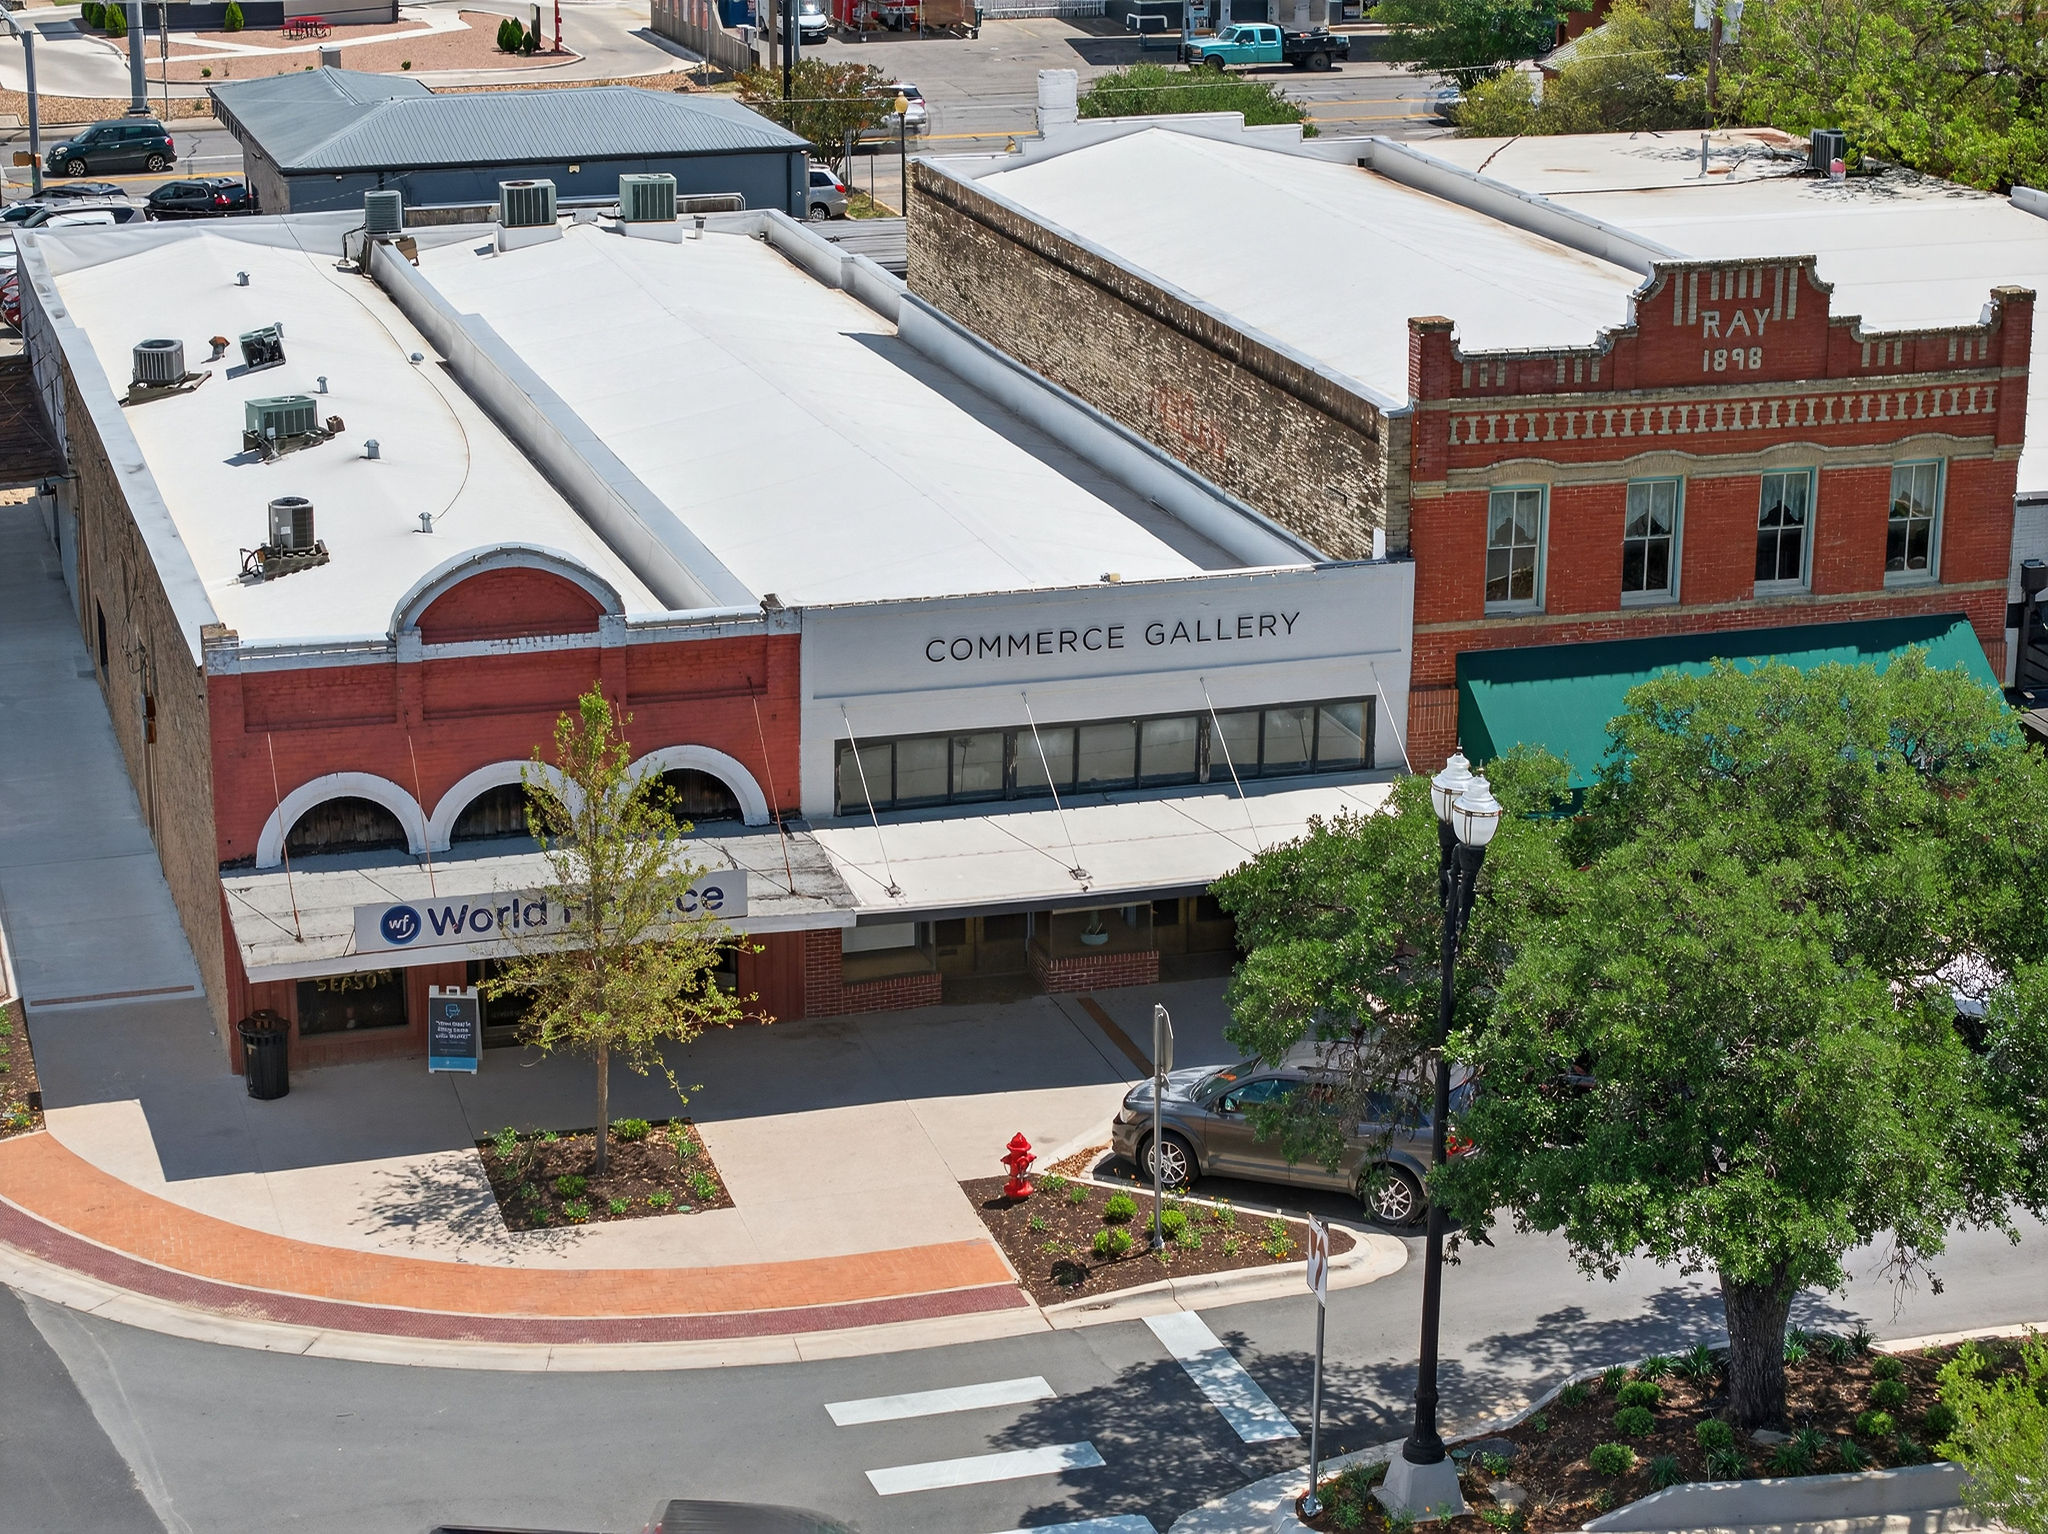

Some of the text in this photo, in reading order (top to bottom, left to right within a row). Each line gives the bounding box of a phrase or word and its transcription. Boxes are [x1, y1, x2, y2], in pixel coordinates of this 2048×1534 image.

[1701, 308, 1771, 338] RAY
[1703, 346, 1763, 372] 1898
[925, 611, 1301, 662] COMMERCE GALLERY
[427, 896, 548, 937] World
